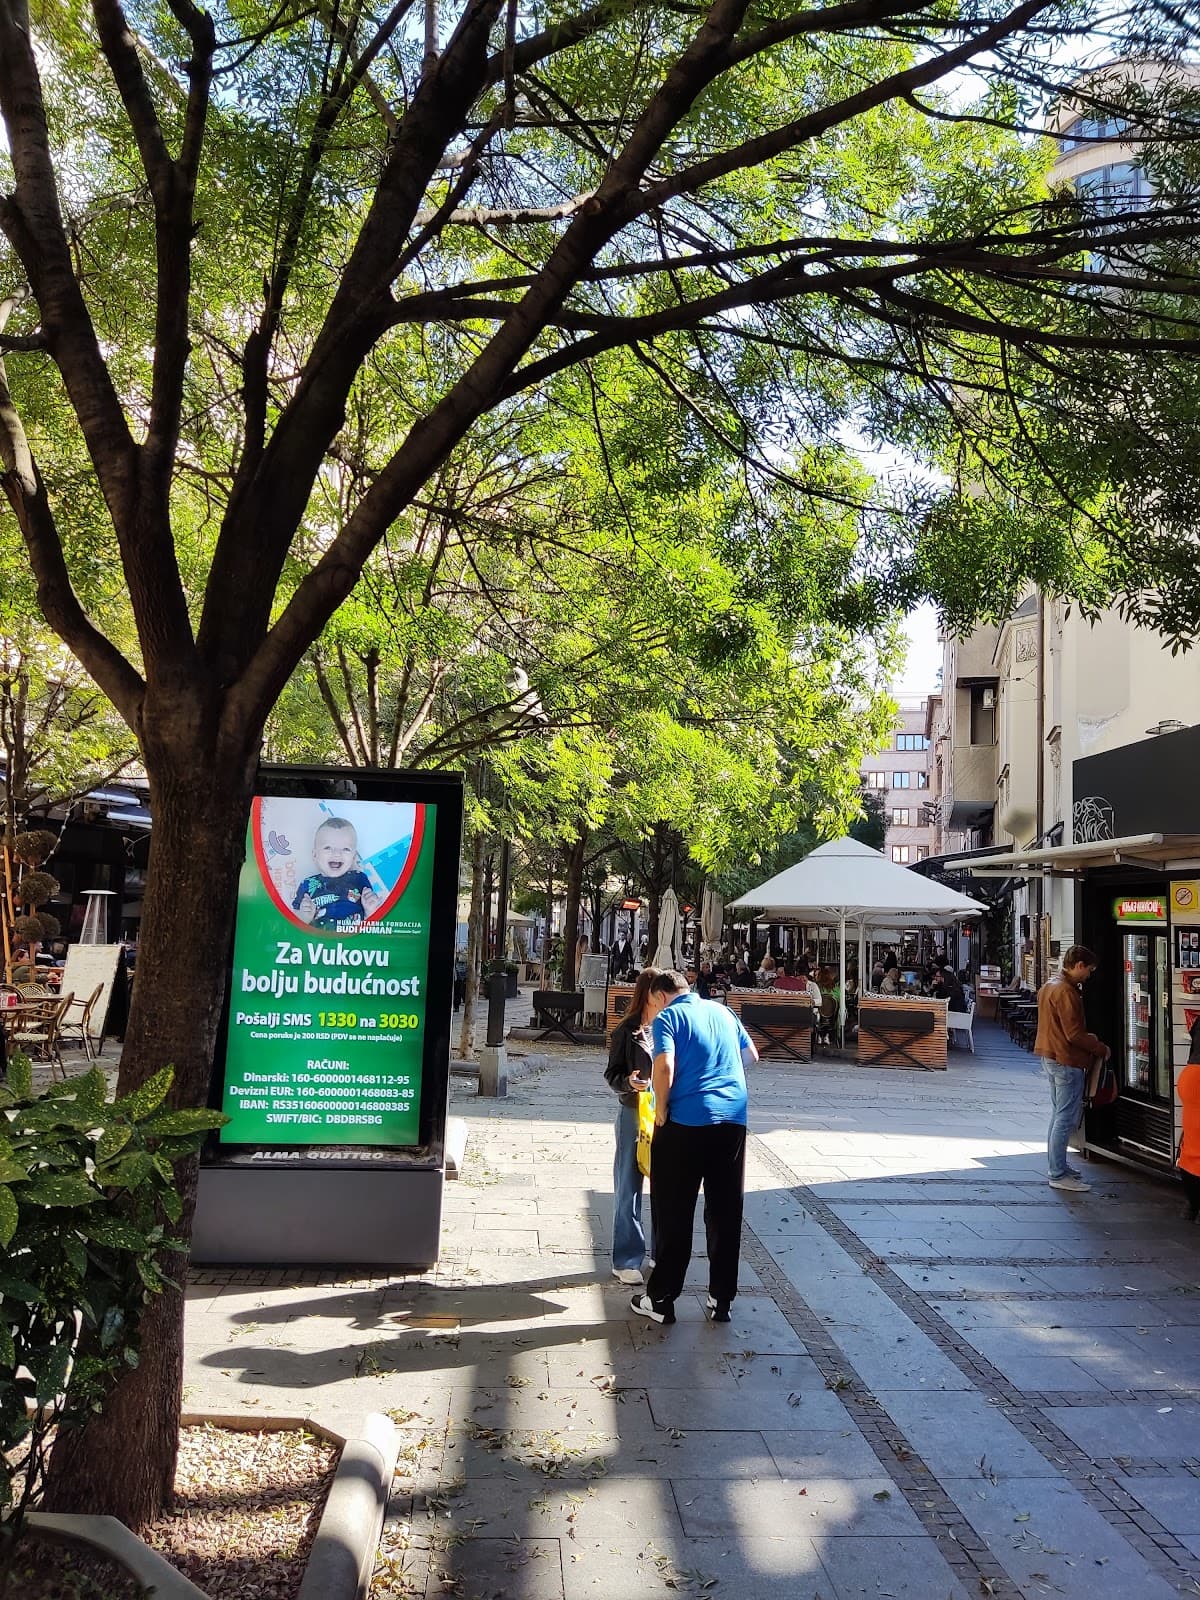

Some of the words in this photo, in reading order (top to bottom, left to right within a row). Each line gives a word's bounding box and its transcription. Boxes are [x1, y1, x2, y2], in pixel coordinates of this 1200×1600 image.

[360, 926, 392, 934] HUMAN
[275, 941, 303, 965] Za
[307, 942, 390, 967] Vukovu
[242, 968, 299, 999] bolju
[303, 971, 420, 997] budućnost
[236, 1011, 280, 1028] Pošalji
[283, 1013, 312, 1026] SMS
[318, 1012, 357, 1028] 1330
[360, 1017, 377, 1028] na
[379, 1013, 419, 1029] 3030
[250, 1031, 268, 1039] Cena
[268, 1032, 293, 1041] poruke
[294, 1032, 301, 1040] je
[302, 1032, 315, 1040] 200
[307, 1059, 350, 1070] RAČUNI:
[243, 1072, 289, 1083] Dinarski:
[292, 1074, 410, 1085] 160-6000001468112-95
[230, 1086, 268, 1096] Devizni
[270, 1086, 294, 1096] EUR:
[296, 1087, 415, 1098] 160-6000001468083-85
[240, 1100, 270, 1110] IBAN:
[266, 1114, 322, 1124] SWIFT/BIC:
[326, 1114, 382, 1124] DBDBRSBG
[251, 1151, 300, 1160] ALMA
[306, 1152, 384, 1161] QUATTRO
